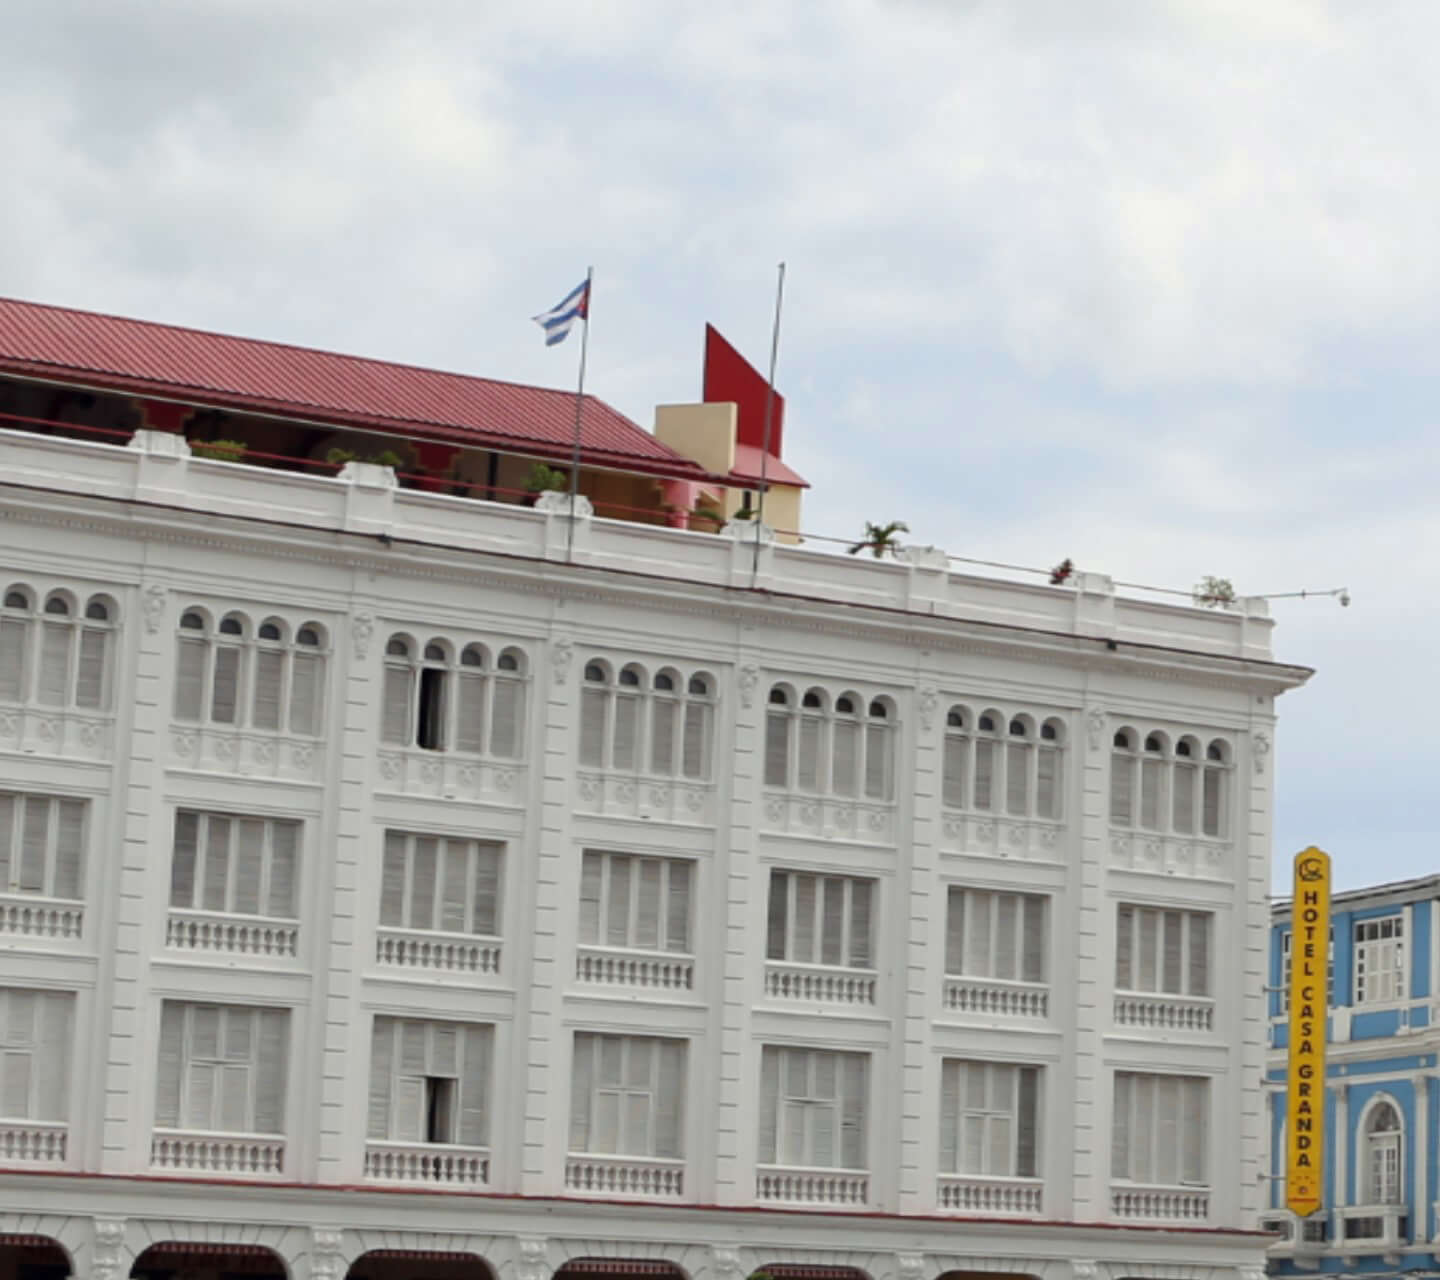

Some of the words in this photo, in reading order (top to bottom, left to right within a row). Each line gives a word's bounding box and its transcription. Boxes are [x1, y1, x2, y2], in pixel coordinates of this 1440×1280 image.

[1303, 890, 1318, 976] HOTEL
[1299, 986, 1315, 1054] CASA
[1296, 1064, 1314, 1167] GRANDA
